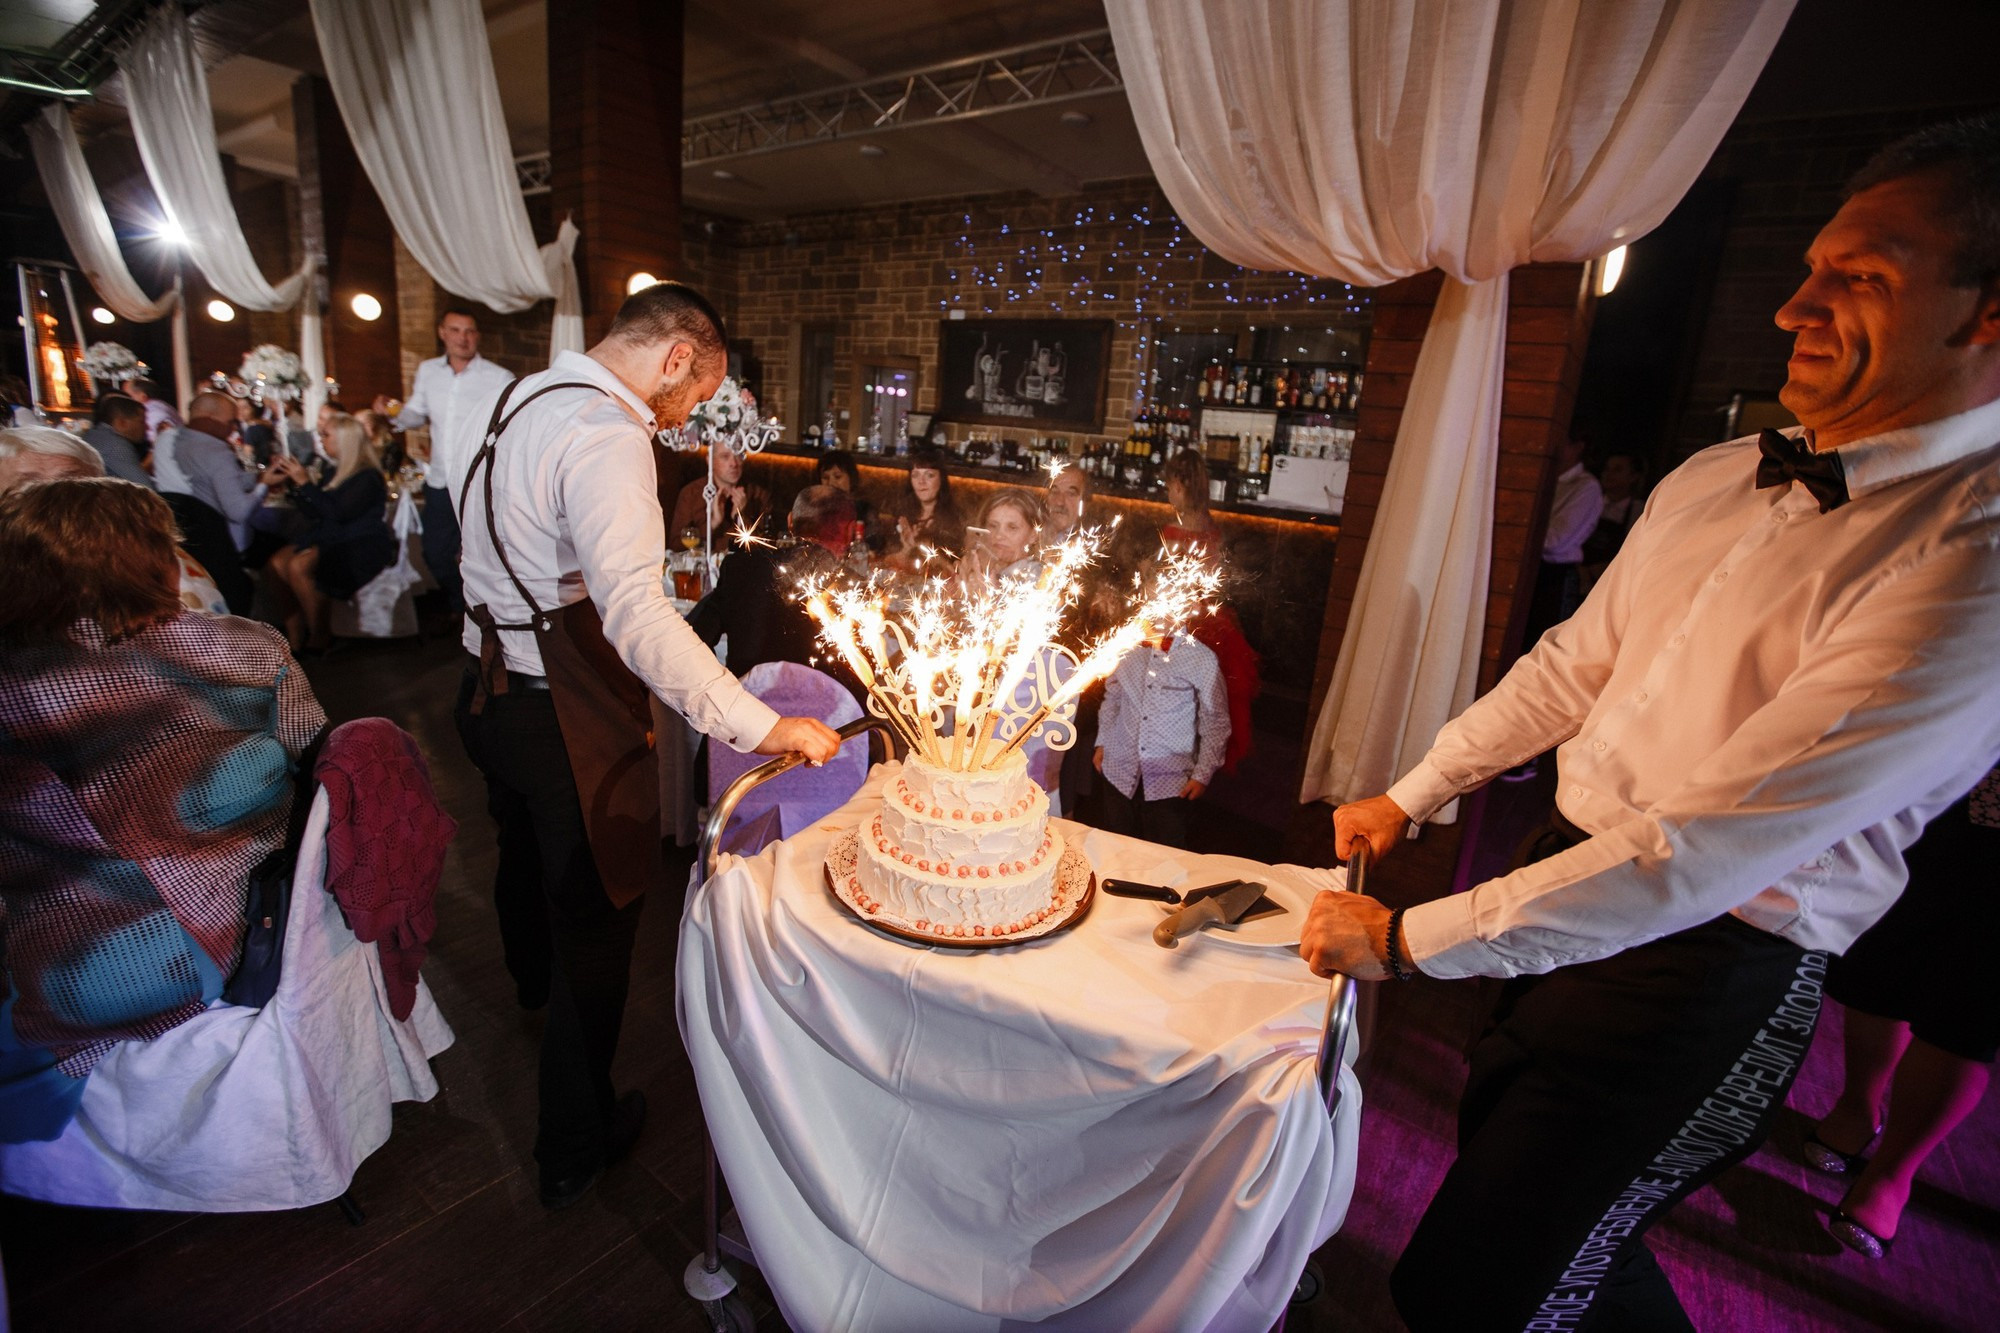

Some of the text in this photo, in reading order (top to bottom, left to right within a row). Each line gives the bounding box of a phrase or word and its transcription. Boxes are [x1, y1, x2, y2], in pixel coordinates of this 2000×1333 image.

[1522, 951, 1828, 1333] РНОЕ УПОТРЕБЛЕНИЕ АЛКОГОЛЯ ВРЕДИТ ЗДОРОВ
